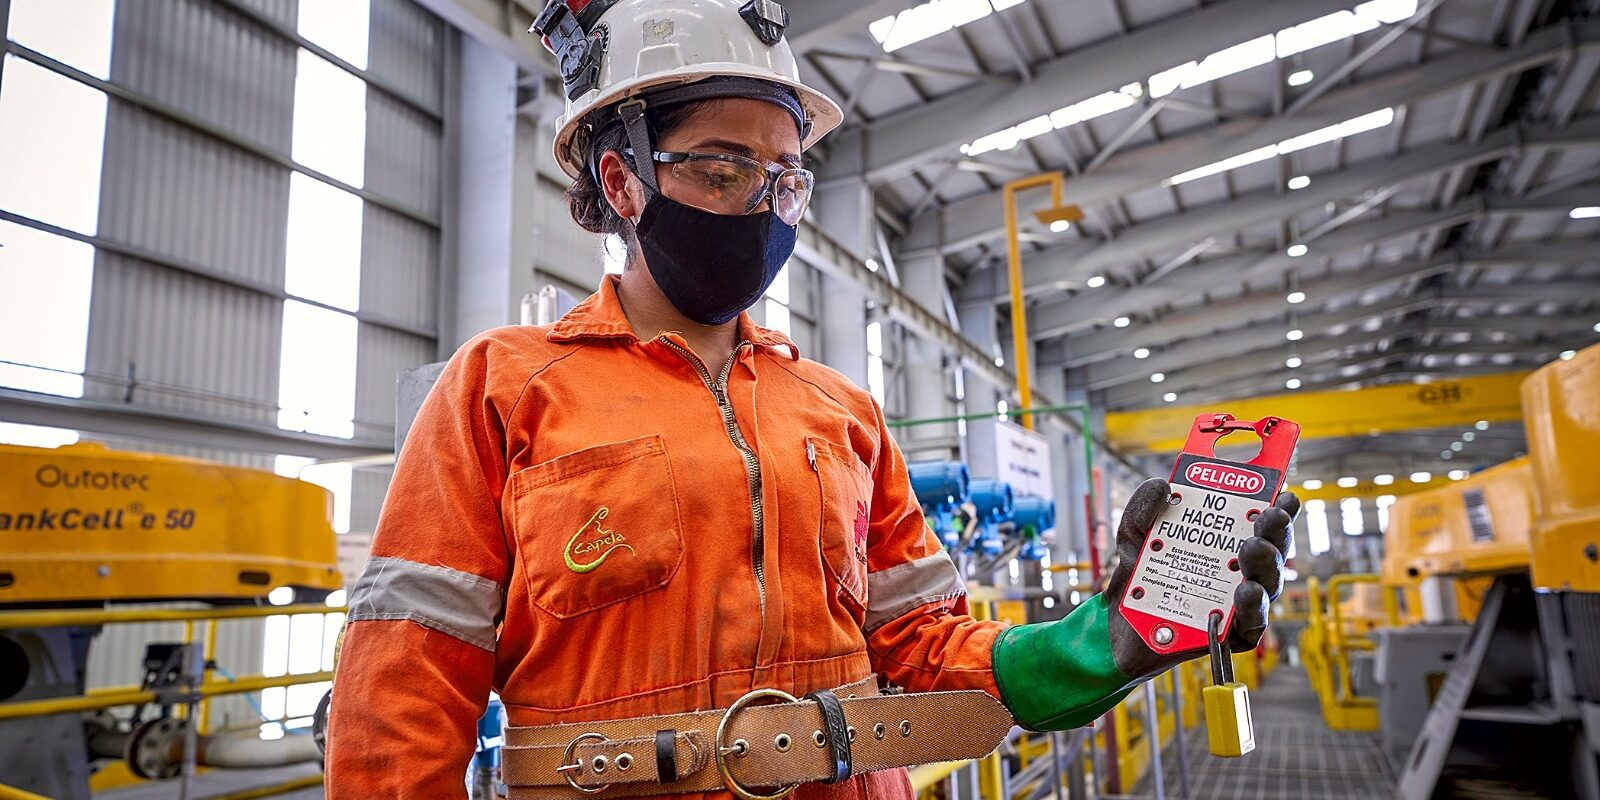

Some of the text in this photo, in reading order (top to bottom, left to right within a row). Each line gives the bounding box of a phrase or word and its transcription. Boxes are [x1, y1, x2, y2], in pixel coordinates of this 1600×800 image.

[35, 464, 150, 491] Outotec
[1189, 466, 1260, 490] PELIGRO
[1202, 494, 1227, 511] NO
[164, 508, 196, 530] 50
[1182, 508, 1236, 533] HACER
[574, 531, 627, 554] Capela
[1149, 557, 1169, 566] Nombre
